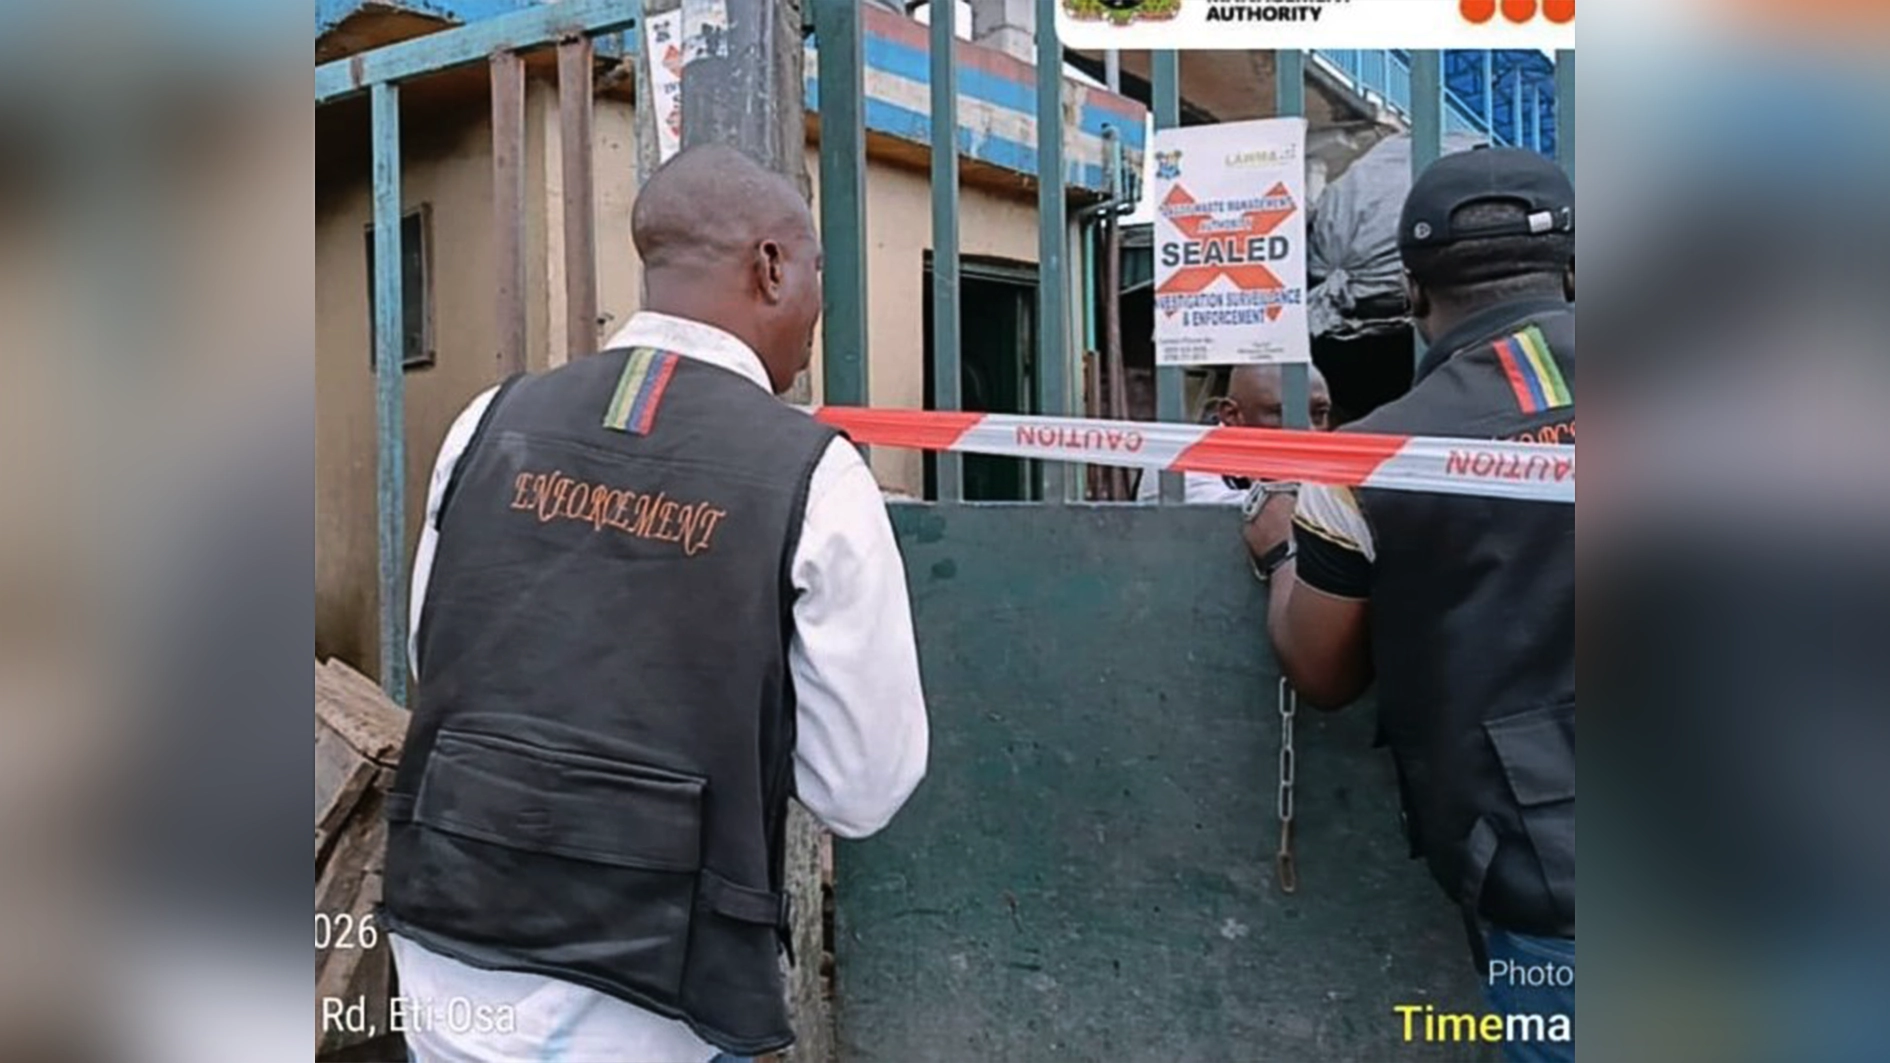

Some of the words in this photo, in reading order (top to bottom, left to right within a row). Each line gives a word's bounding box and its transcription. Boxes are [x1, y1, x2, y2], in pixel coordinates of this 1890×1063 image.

[1161, 236, 1289, 267] SEALED
[1192, 308, 1264, 326] ENFORCEMENT
[1016, 425, 1143, 453] CAUTION
[1446, 449, 1575, 483] AUTION
[510, 470, 727, 556] ENFORCEMENT
